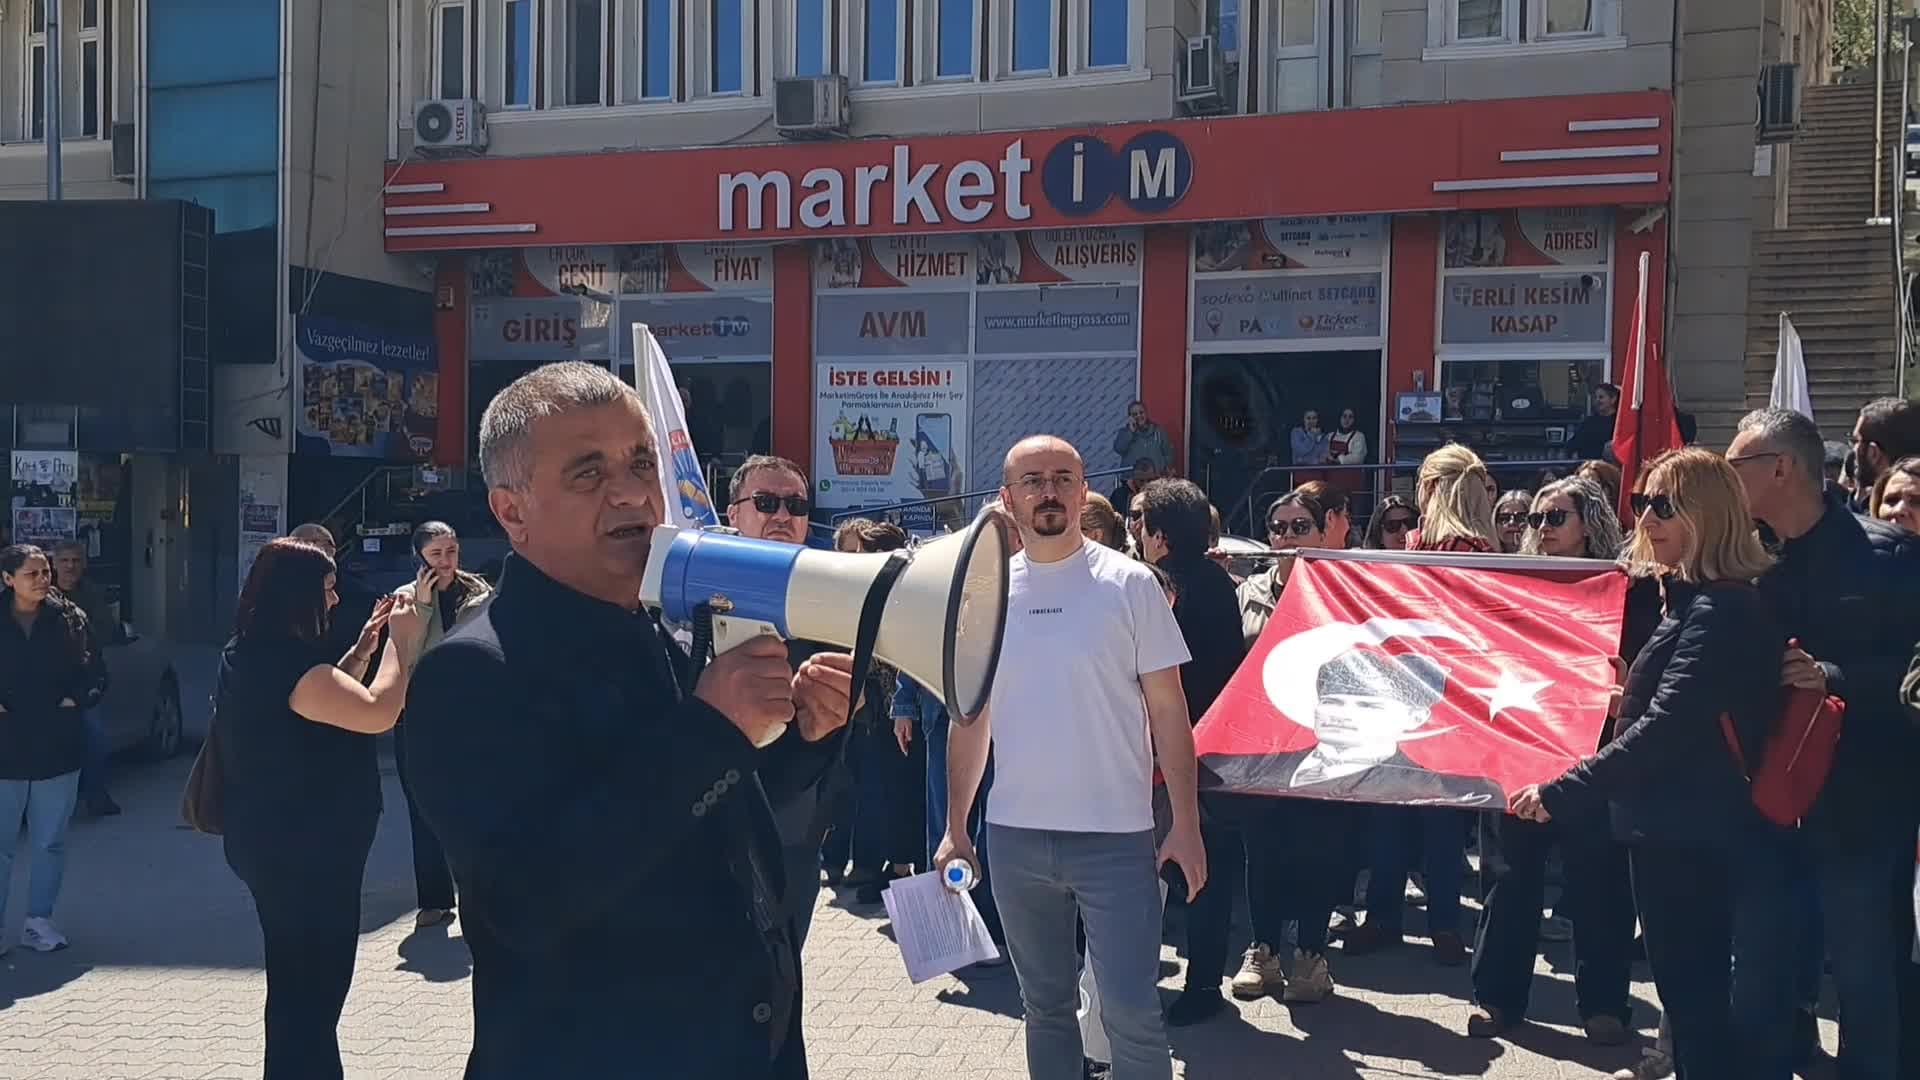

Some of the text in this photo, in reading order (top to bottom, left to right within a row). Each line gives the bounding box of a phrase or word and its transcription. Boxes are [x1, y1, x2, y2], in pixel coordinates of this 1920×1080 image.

[455, 105, 465, 142] VESTEL
[718, 138, 1032, 231] market
[897, 250, 969, 277] HİZMET
[1055, 241, 1137, 268] ALIŞVERİŞ
[713, 256, 762, 282] FİYAT
[1524, 282, 1590, 305] KESİM
[503, 313, 577, 349] GİRİŞ
[859, 311, 928, 338] AVM
[1490, 315, 1558, 333] KASAP
[306, 327, 379, 354] Vazgeçilmez
[829, 366, 868, 386] İSTE
[873, 366, 941, 386] GELSİN
